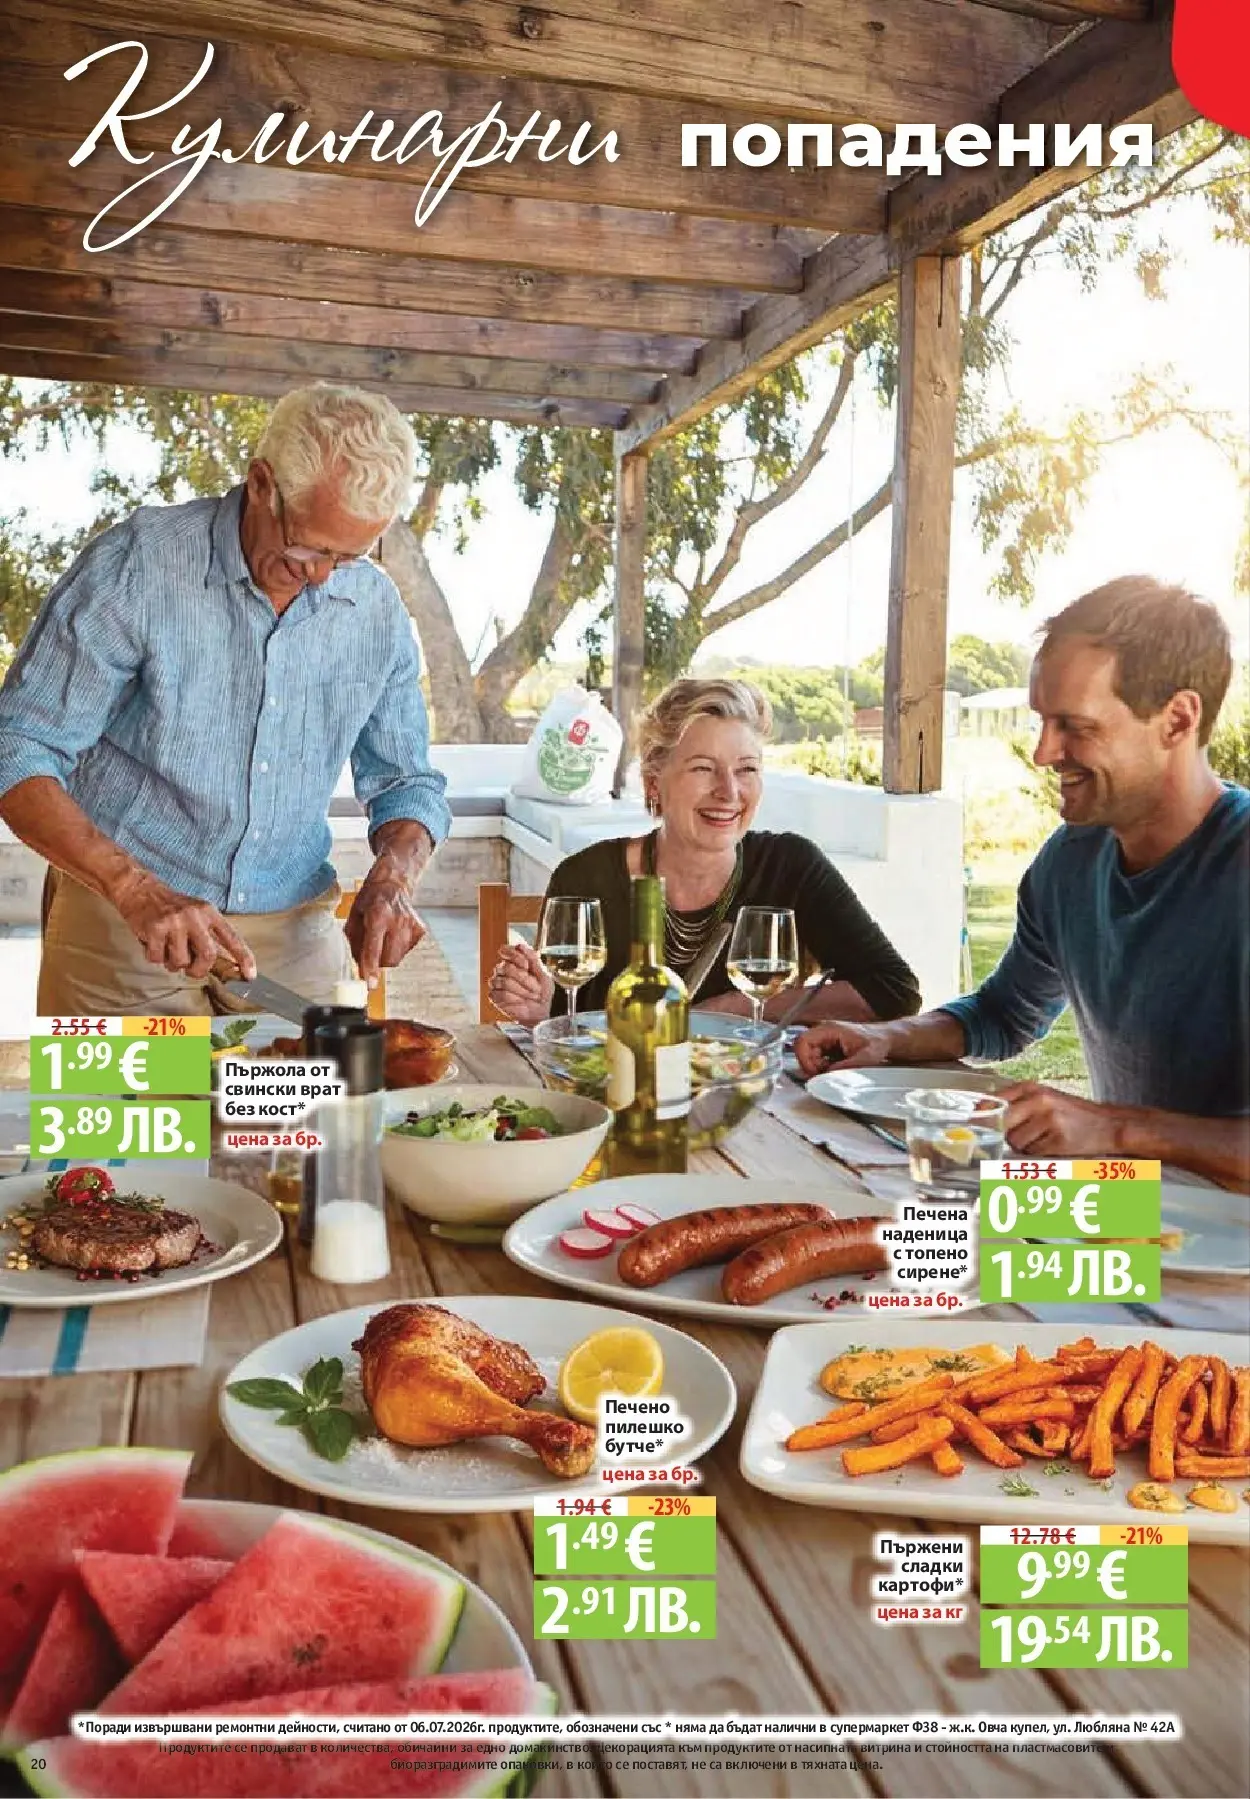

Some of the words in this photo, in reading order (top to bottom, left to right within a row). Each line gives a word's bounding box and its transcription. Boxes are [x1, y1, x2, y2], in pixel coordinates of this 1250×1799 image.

[63, 40, 620, 253] Кулинарни
[681, 123, 1155, 178] попадения
[52, 1018, 91, 1036] 2.55
[96, 1019, 107, 1036] €
[143, 1018, 186, 1036] -21%
[41, 1041, 113, 1090] 1.99
[118, 1040, 150, 1091] €
[225, 1062, 306, 1081] Пържола
[310, 1066, 331, 1077] от
[225, 1084, 296, 1096] свински
[300, 1084, 342, 1100] врат
[225, 1100, 256, 1116] без
[38, 1106, 113, 1154] 3.89
[117, 1106, 196, 1153] ЛВ.
[227, 1134, 269, 1147] цена
[273, 1134, 291, 1146] за
[295, 1131, 322, 1151] бр.
[1003, 1162, 1040, 1180] 1.53
[1046, 1163, 1057, 1180] €
[1093, 1162, 1136, 1180] -35%
[903, 1206, 968, 1221] Печена
[988, 1184, 1063, 1233] 0.99
[1069, 1183, 1101, 1234] €
[882, 1229, 968, 1244] наденица
[893, 1248, 902, 1260] с
[904, 1248, 968, 1260] топено
[991, 1249, 1063, 1298] 1.94
[1067, 1249, 1146, 1296] ЛВ.
[868, 1296, 910, 1309] цена
[913, 1296, 932, 1307] за
[936, 1291, 963, 1310] бр.
[605, 1399, 670, 1414] Печено
[605, 1422, 684, 1434] пилешко
[602, 1470, 645, 1483] цена
[648, 1470, 667, 1481] за
[671, 1466, 698, 1485] бр.
[557, 1498, 596, 1516] 1.94
[601, 1499, 612, 1516] €
[648, 1498, 691, 1516] -23%
[1011, 1527, 1061, 1545] 12.78
[1065, 1528, 1076, 1545] €
[1119, 1527, 1163, 1545] -21%
[546, 1521, 619, 1570] 1.49
[624, 1520, 656, 1572] €
[880, 1539, 963, 1558] Пържени
[901, 1562, 963, 1576] сладки
[1017, 1550, 1091, 1599] 9.99
[1096, 1549, 1128, 1600] €
[541, 1586, 615, 1634] 2.91
[623, 1586, 701, 1633] ЛВ.
[877, 1607, 919, 1620] цена
[922, 1608, 941, 1619] за
[945, 1608, 963, 1619] кг
[991, 1615, 1091, 1663] 19.54
[1095, 1615, 1173, 1662] ЛВ.
[134, 1723, 213, 1736] извършвани
[215, 1723, 276, 1736] ремонтни
[277, 1720, 340, 1736] дейности,
[343, 1723, 391, 1733] считано
[394, 1723, 408, 1733] от
[410, 1721, 486, 1733] 06.07.2026г.
[488, 1723, 563, 1736] продуктите,
[566, 1720, 639, 1733] обозначени
[641, 1723, 662, 1733] със
[675, 1723, 707, 1733] няма
[709, 1723, 725, 1735] да
[726, 1720, 763, 1735] бъдат
[764, 1723, 817, 1733] налични
[819, 1723, 827, 1733] в
[830, 1723, 910, 1736] супермаркет
[912, 1720, 939, 1733] Ф38
[948, 1723, 976, 1733] ж.к.
[978, 1721, 1008, 1733] Овча
[1010, 1723, 1050, 1736] купел,
[1052, 1723, 1072, 1736] ул.
[1073, 1720, 1131, 1733] Любляна
[1133, 1721, 1148, 1733] №
[159, 1742, 232, 1756] Продуктите
[234, 1743, 248, 1753] се
[250, 1743, 307, 1755] продават
[310, 1743, 318, 1753] в
[320, 1743, 395, 1755] количества,
[460, 1743, 473, 1753] за
[476, 1743, 506, 1755] едно
[678, 1743, 702, 1753] към
[704, 1743, 776, 1756] продуктите
[778, 1743, 792, 1753] от
[860, 1743, 911, 1756] витрина
[914, 1743, 922, 1753] и
[925, 1740, 992, 1753] стойността
[994, 1743, 1009, 1753] на
[30, 1758, 47, 1770] 20
[389, 1757, 498, 1772] биоразградимите
[566, 1760, 574, 1770] в
[615, 1760, 630, 1770] се
[632, 1760, 688, 1771] поставят,
[691, 1760, 707, 1770] не
[709, 1760, 722, 1770] са
[725, 1760, 787, 1770] включени
[790, 1760, 798, 1770] в
[801, 1760, 847, 1770] тяхната
[849, 1760, 883, 1771] цена.
